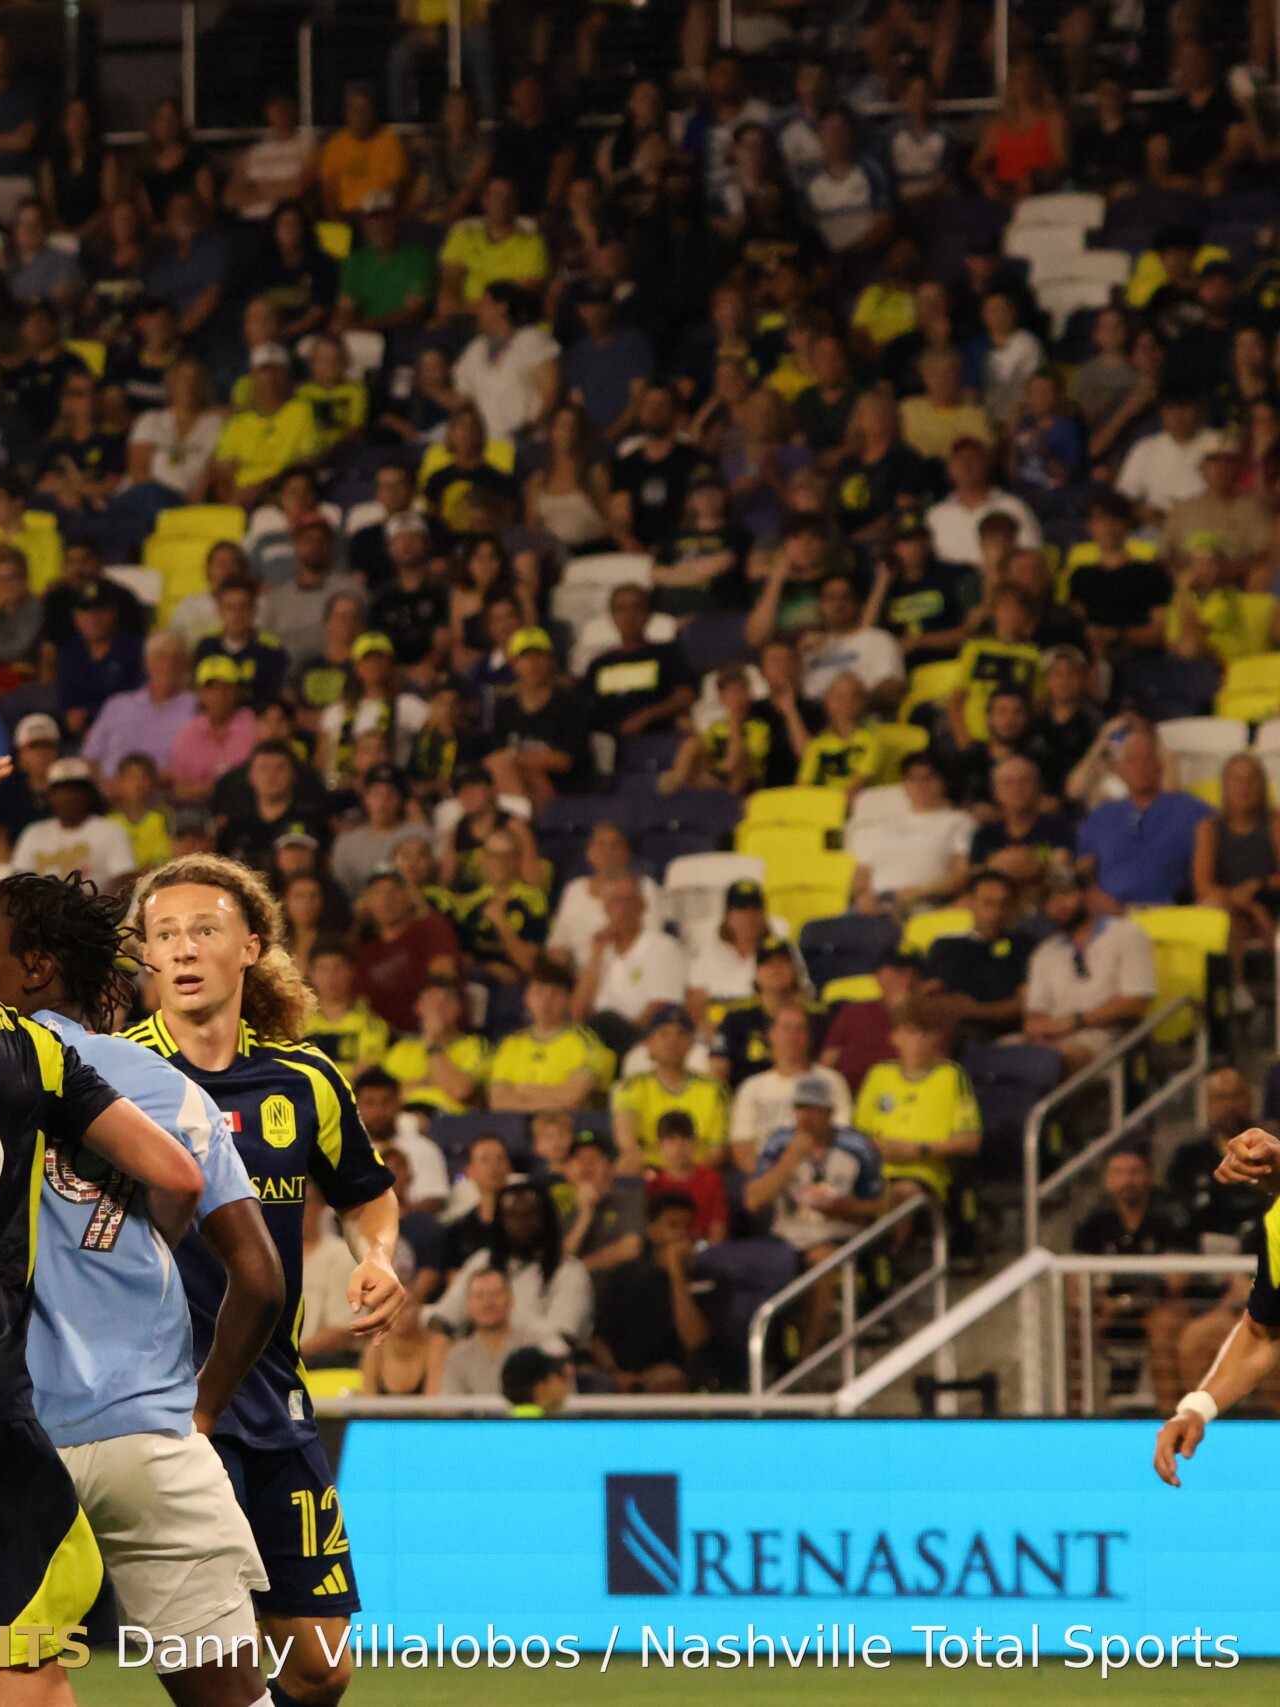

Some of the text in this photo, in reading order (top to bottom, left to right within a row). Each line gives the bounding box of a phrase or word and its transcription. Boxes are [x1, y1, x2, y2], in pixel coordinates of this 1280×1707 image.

[251, 1176, 306, 1200] SANT
[290, 1484, 349, 1557] 12
[691, 1529, 1129, 1598] RENASANT
